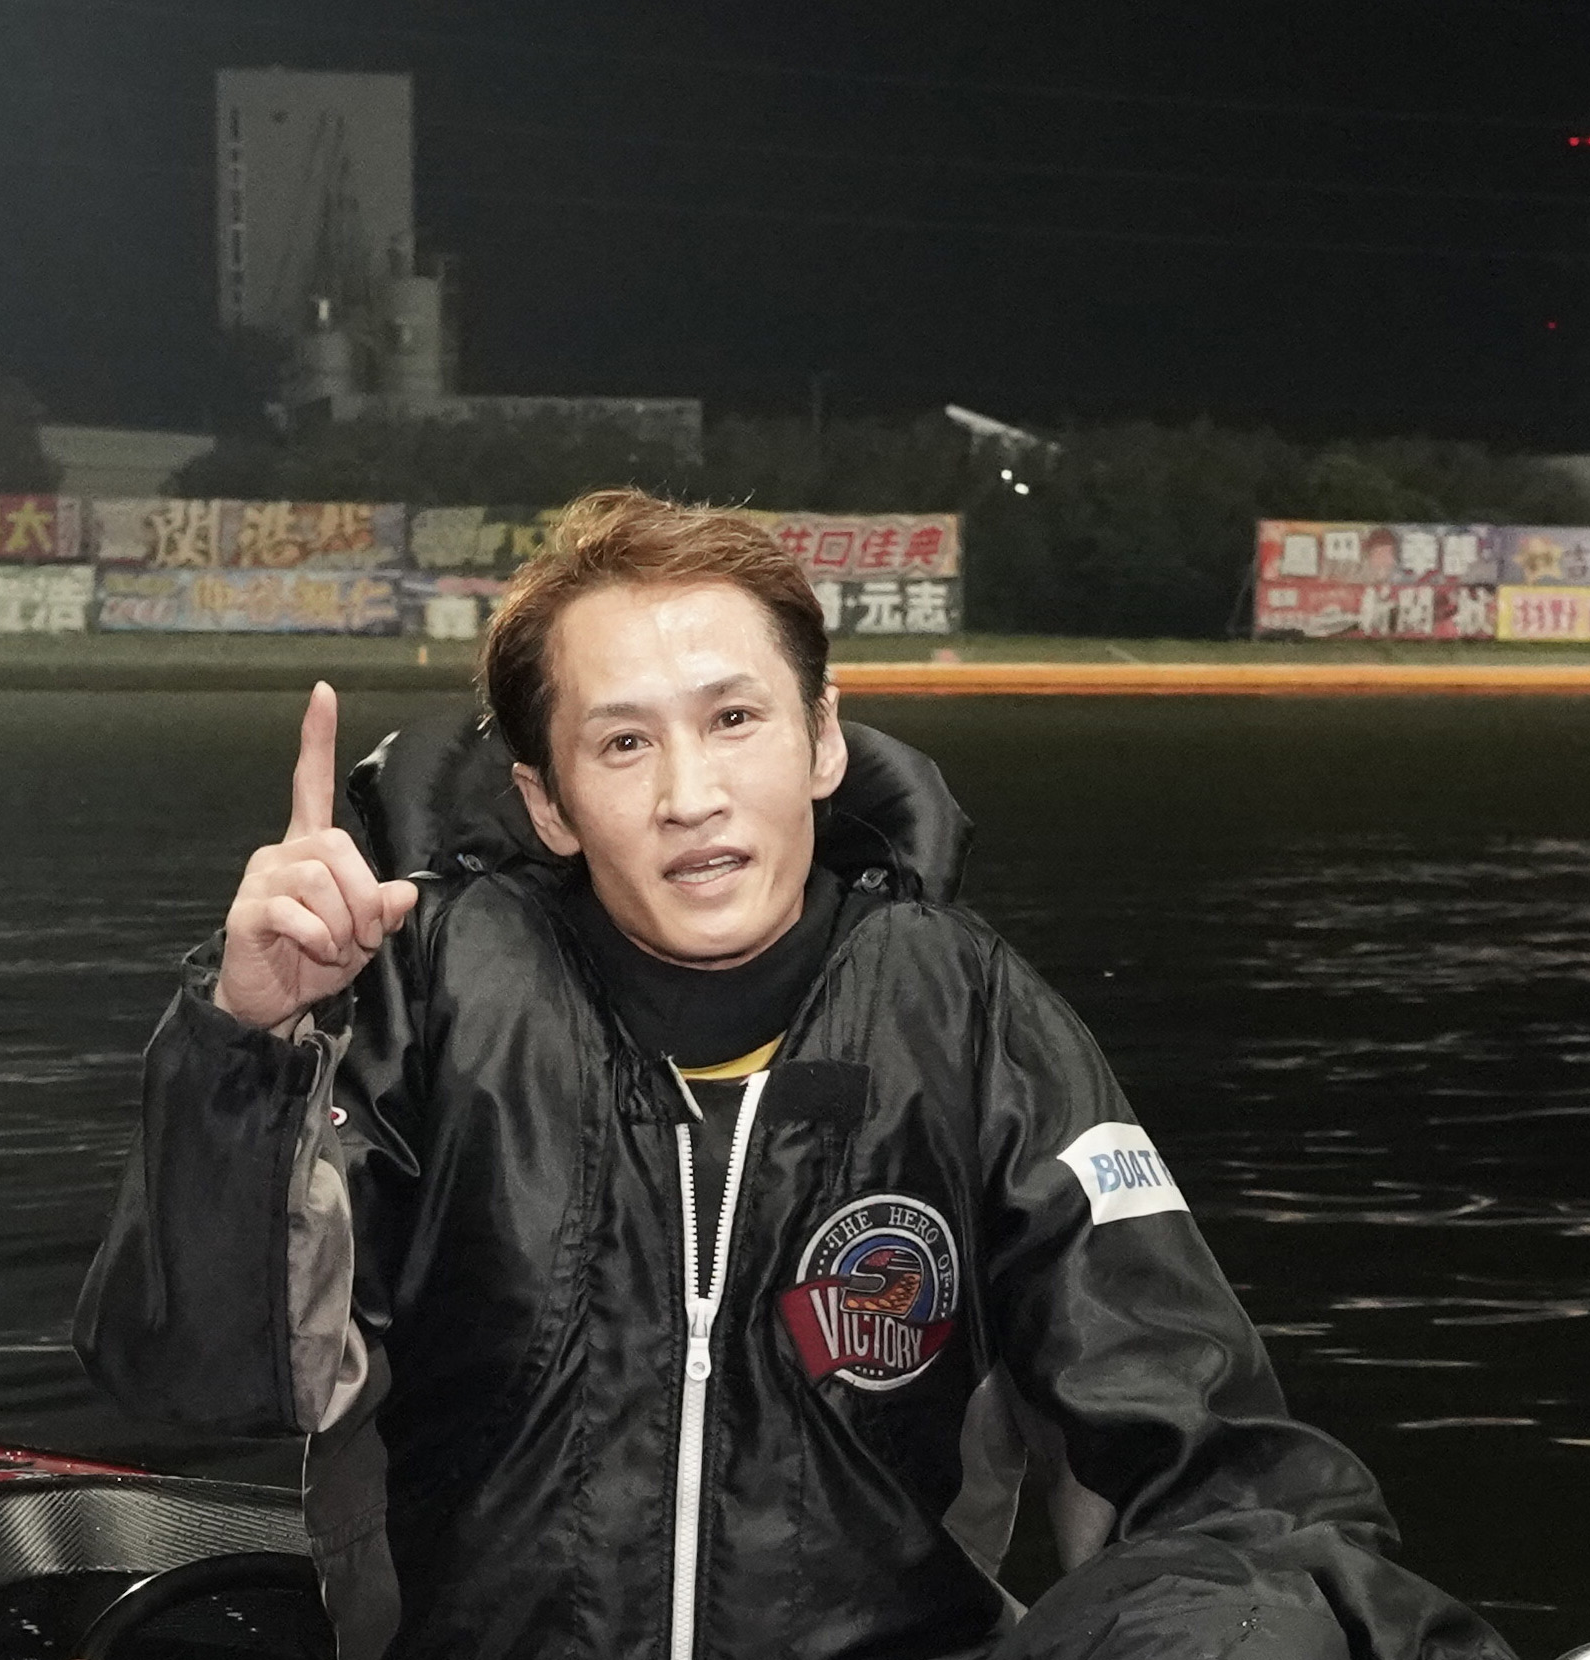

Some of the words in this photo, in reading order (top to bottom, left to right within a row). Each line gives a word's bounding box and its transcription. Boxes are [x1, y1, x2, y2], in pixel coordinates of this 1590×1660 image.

[777, 525, 945, 569] 井口佳典
[1089, 1149, 1162, 1194] BOAT
[825, 1210, 874, 1249] THE
[888, 1206, 940, 1245] HERO
[809, 1286, 924, 1370] VICTORY
